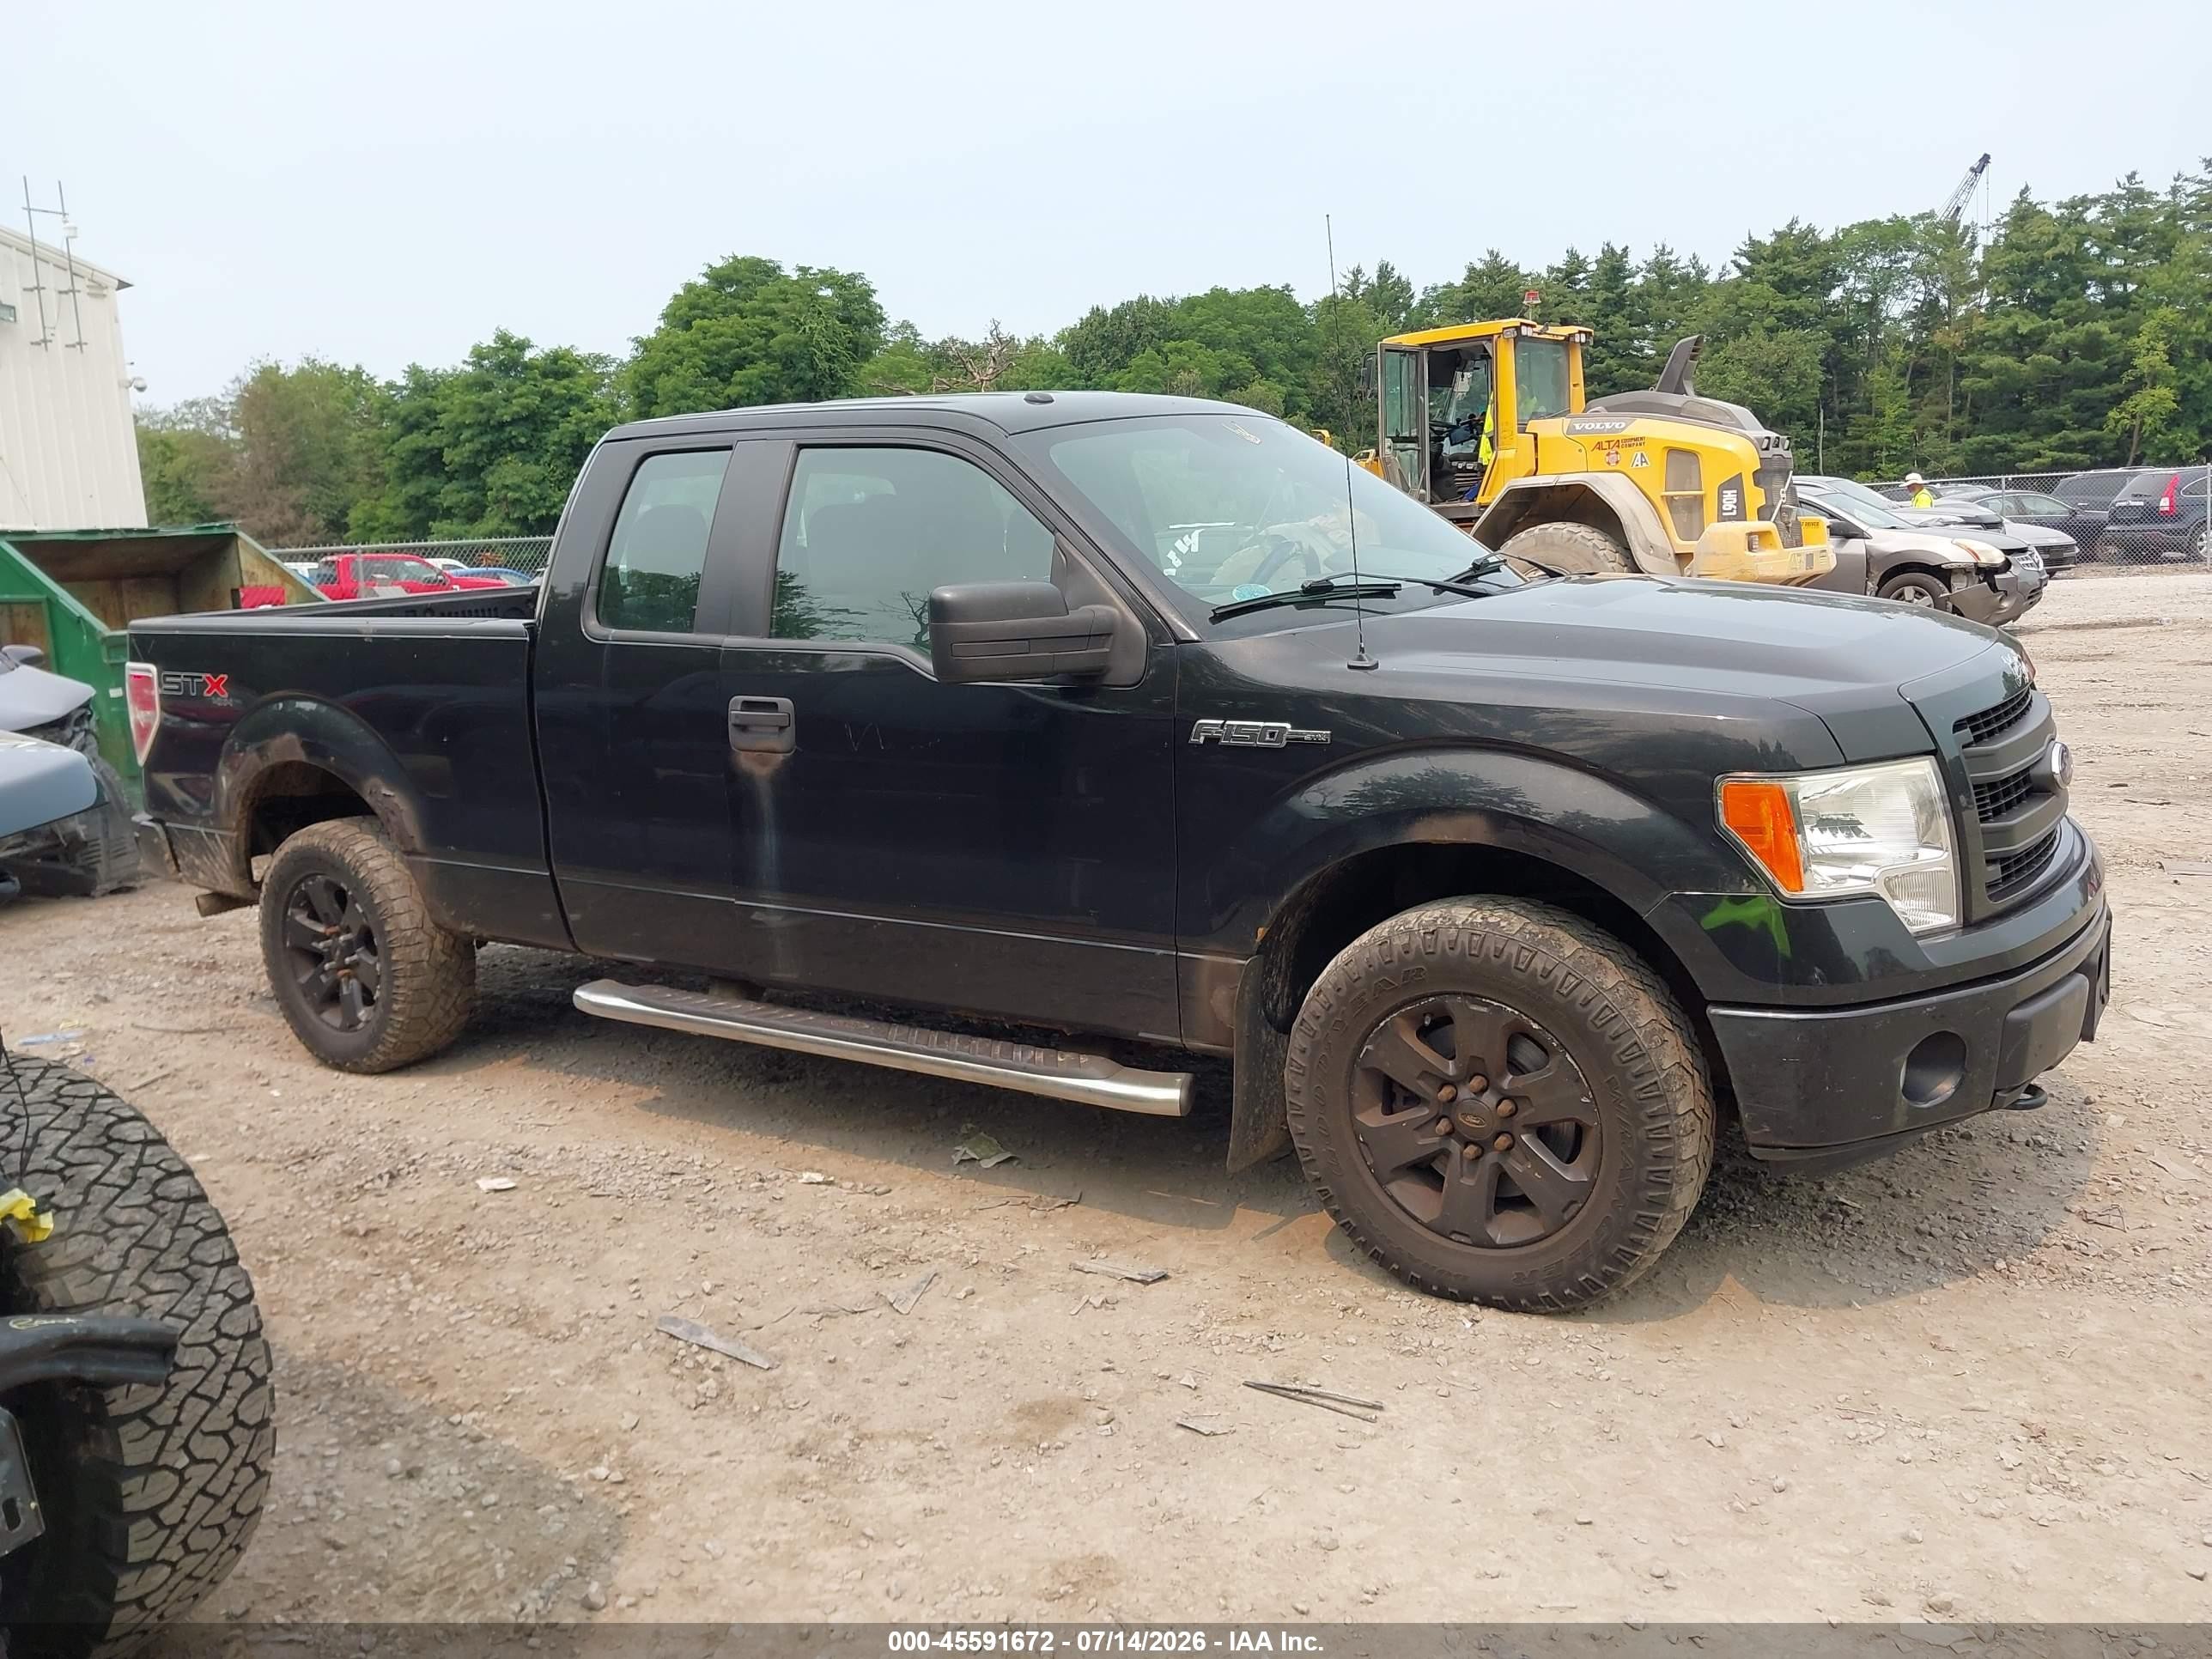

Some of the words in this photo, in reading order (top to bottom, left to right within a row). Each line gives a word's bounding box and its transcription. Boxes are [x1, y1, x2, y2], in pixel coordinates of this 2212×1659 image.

[1572, 422, 1626, 430] VOLVO
[1591, 439, 1620, 452] ALTA
[1722, 489, 1738, 516] L90H
[161, 671, 228, 697] STX
